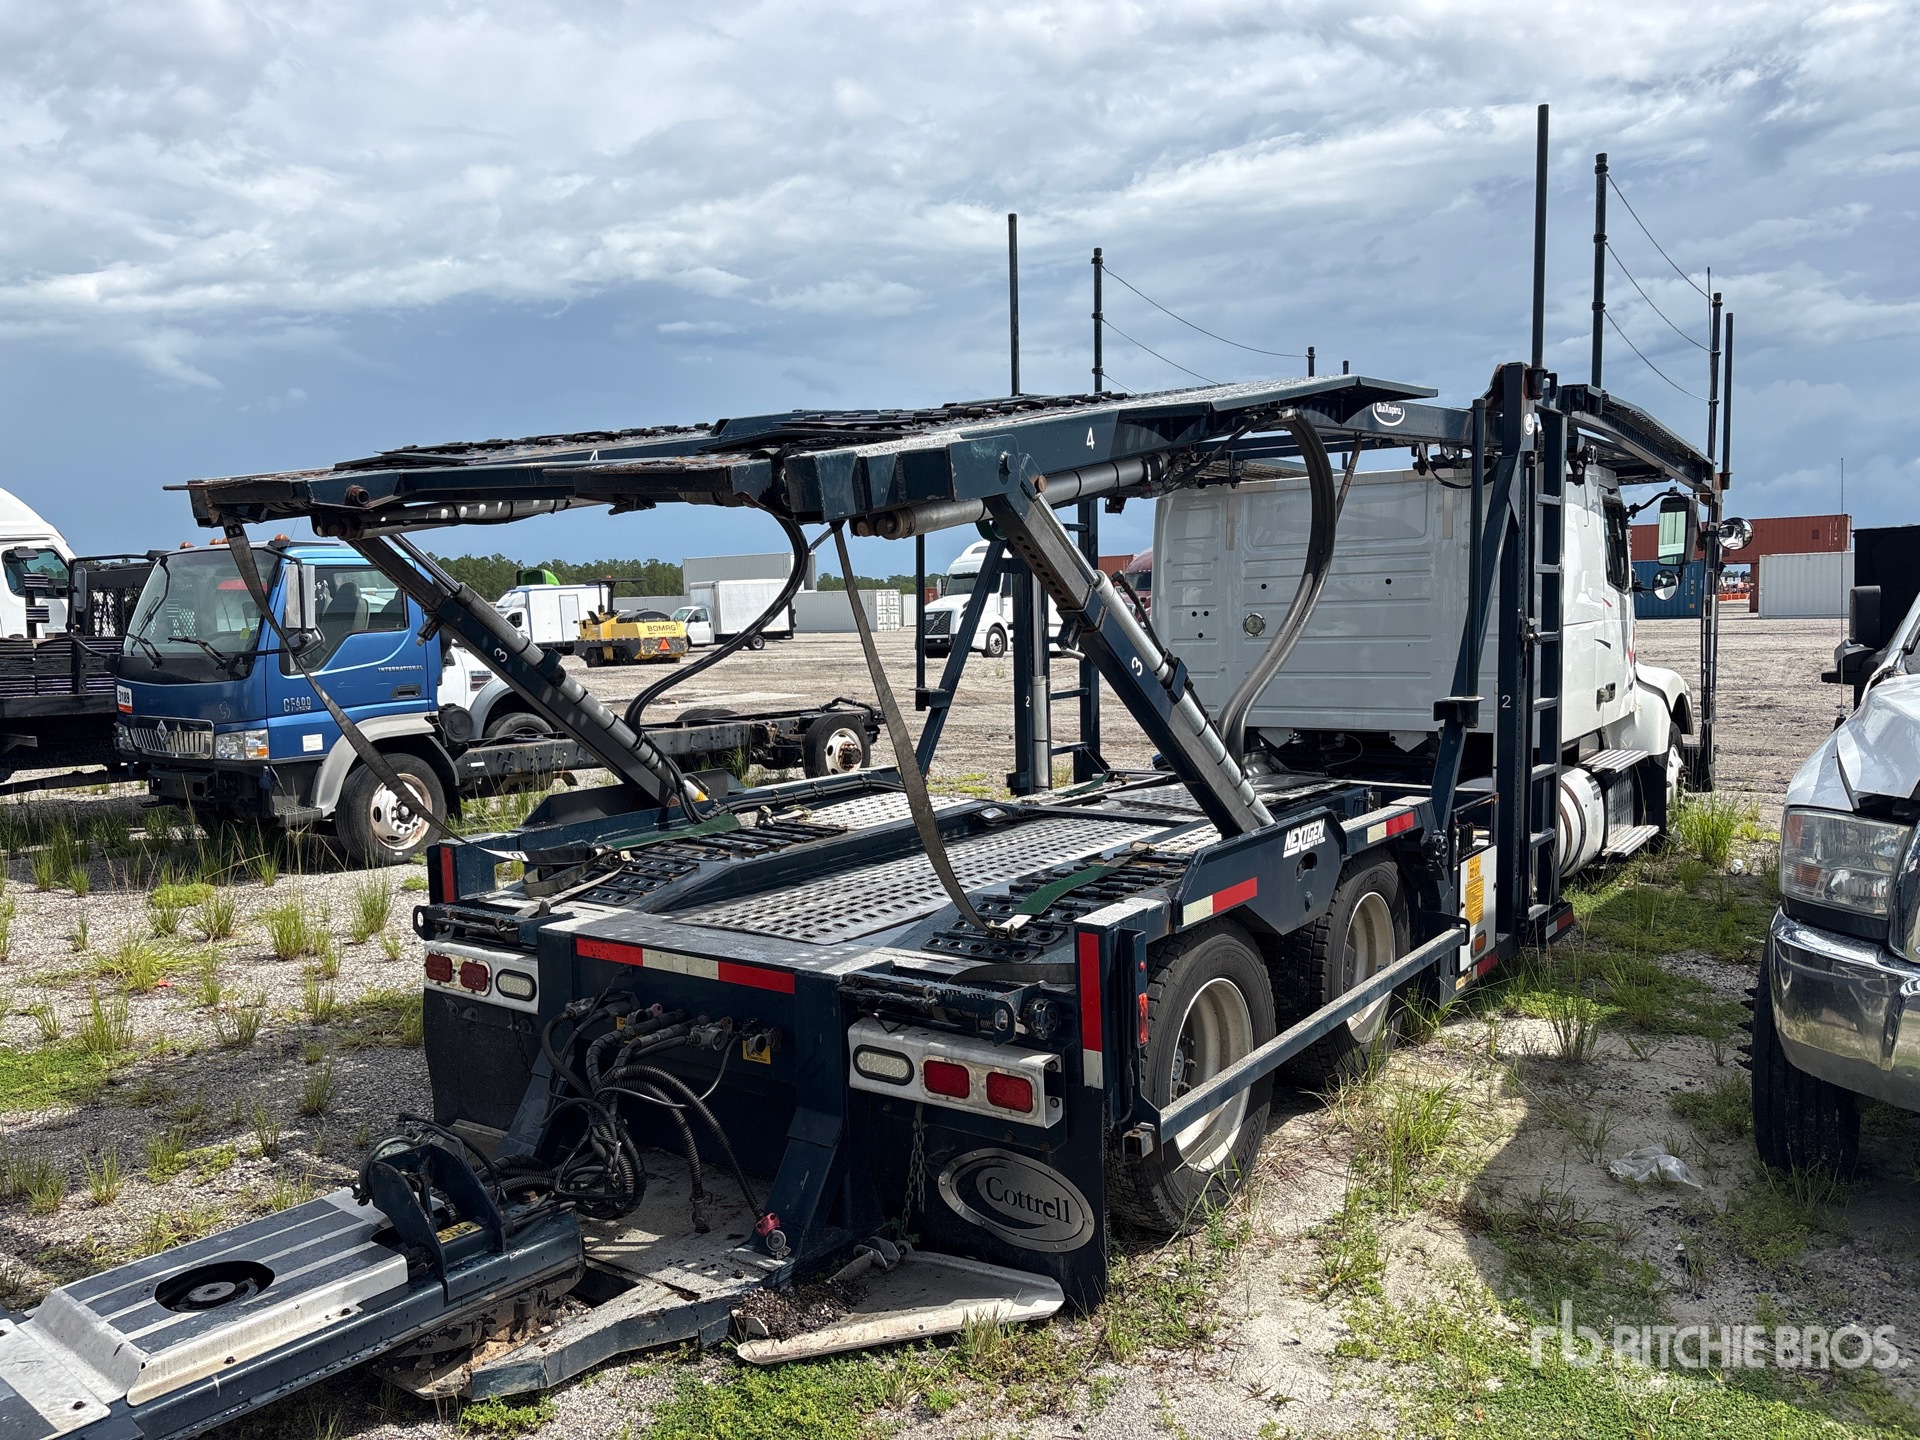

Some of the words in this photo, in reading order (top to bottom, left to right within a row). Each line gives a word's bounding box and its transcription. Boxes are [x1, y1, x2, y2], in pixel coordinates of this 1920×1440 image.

[1086, 426, 1095, 450] 4
[646, 624, 677, 632] BOMAG
[493, 647, 508, 663] 3
[377, 664, 424, 672] INTERNATIONAL
[1131, 656, 1143, 677] 3
[1025, 695, 1031, 708] 2
[1501, 694, 1512, 709] 2
[1283, 818, 1326, 857] NEXTGEN
[985, 1176, 1073, 1225] Cottrell
[439, 1225, 473, 1241] STEP
